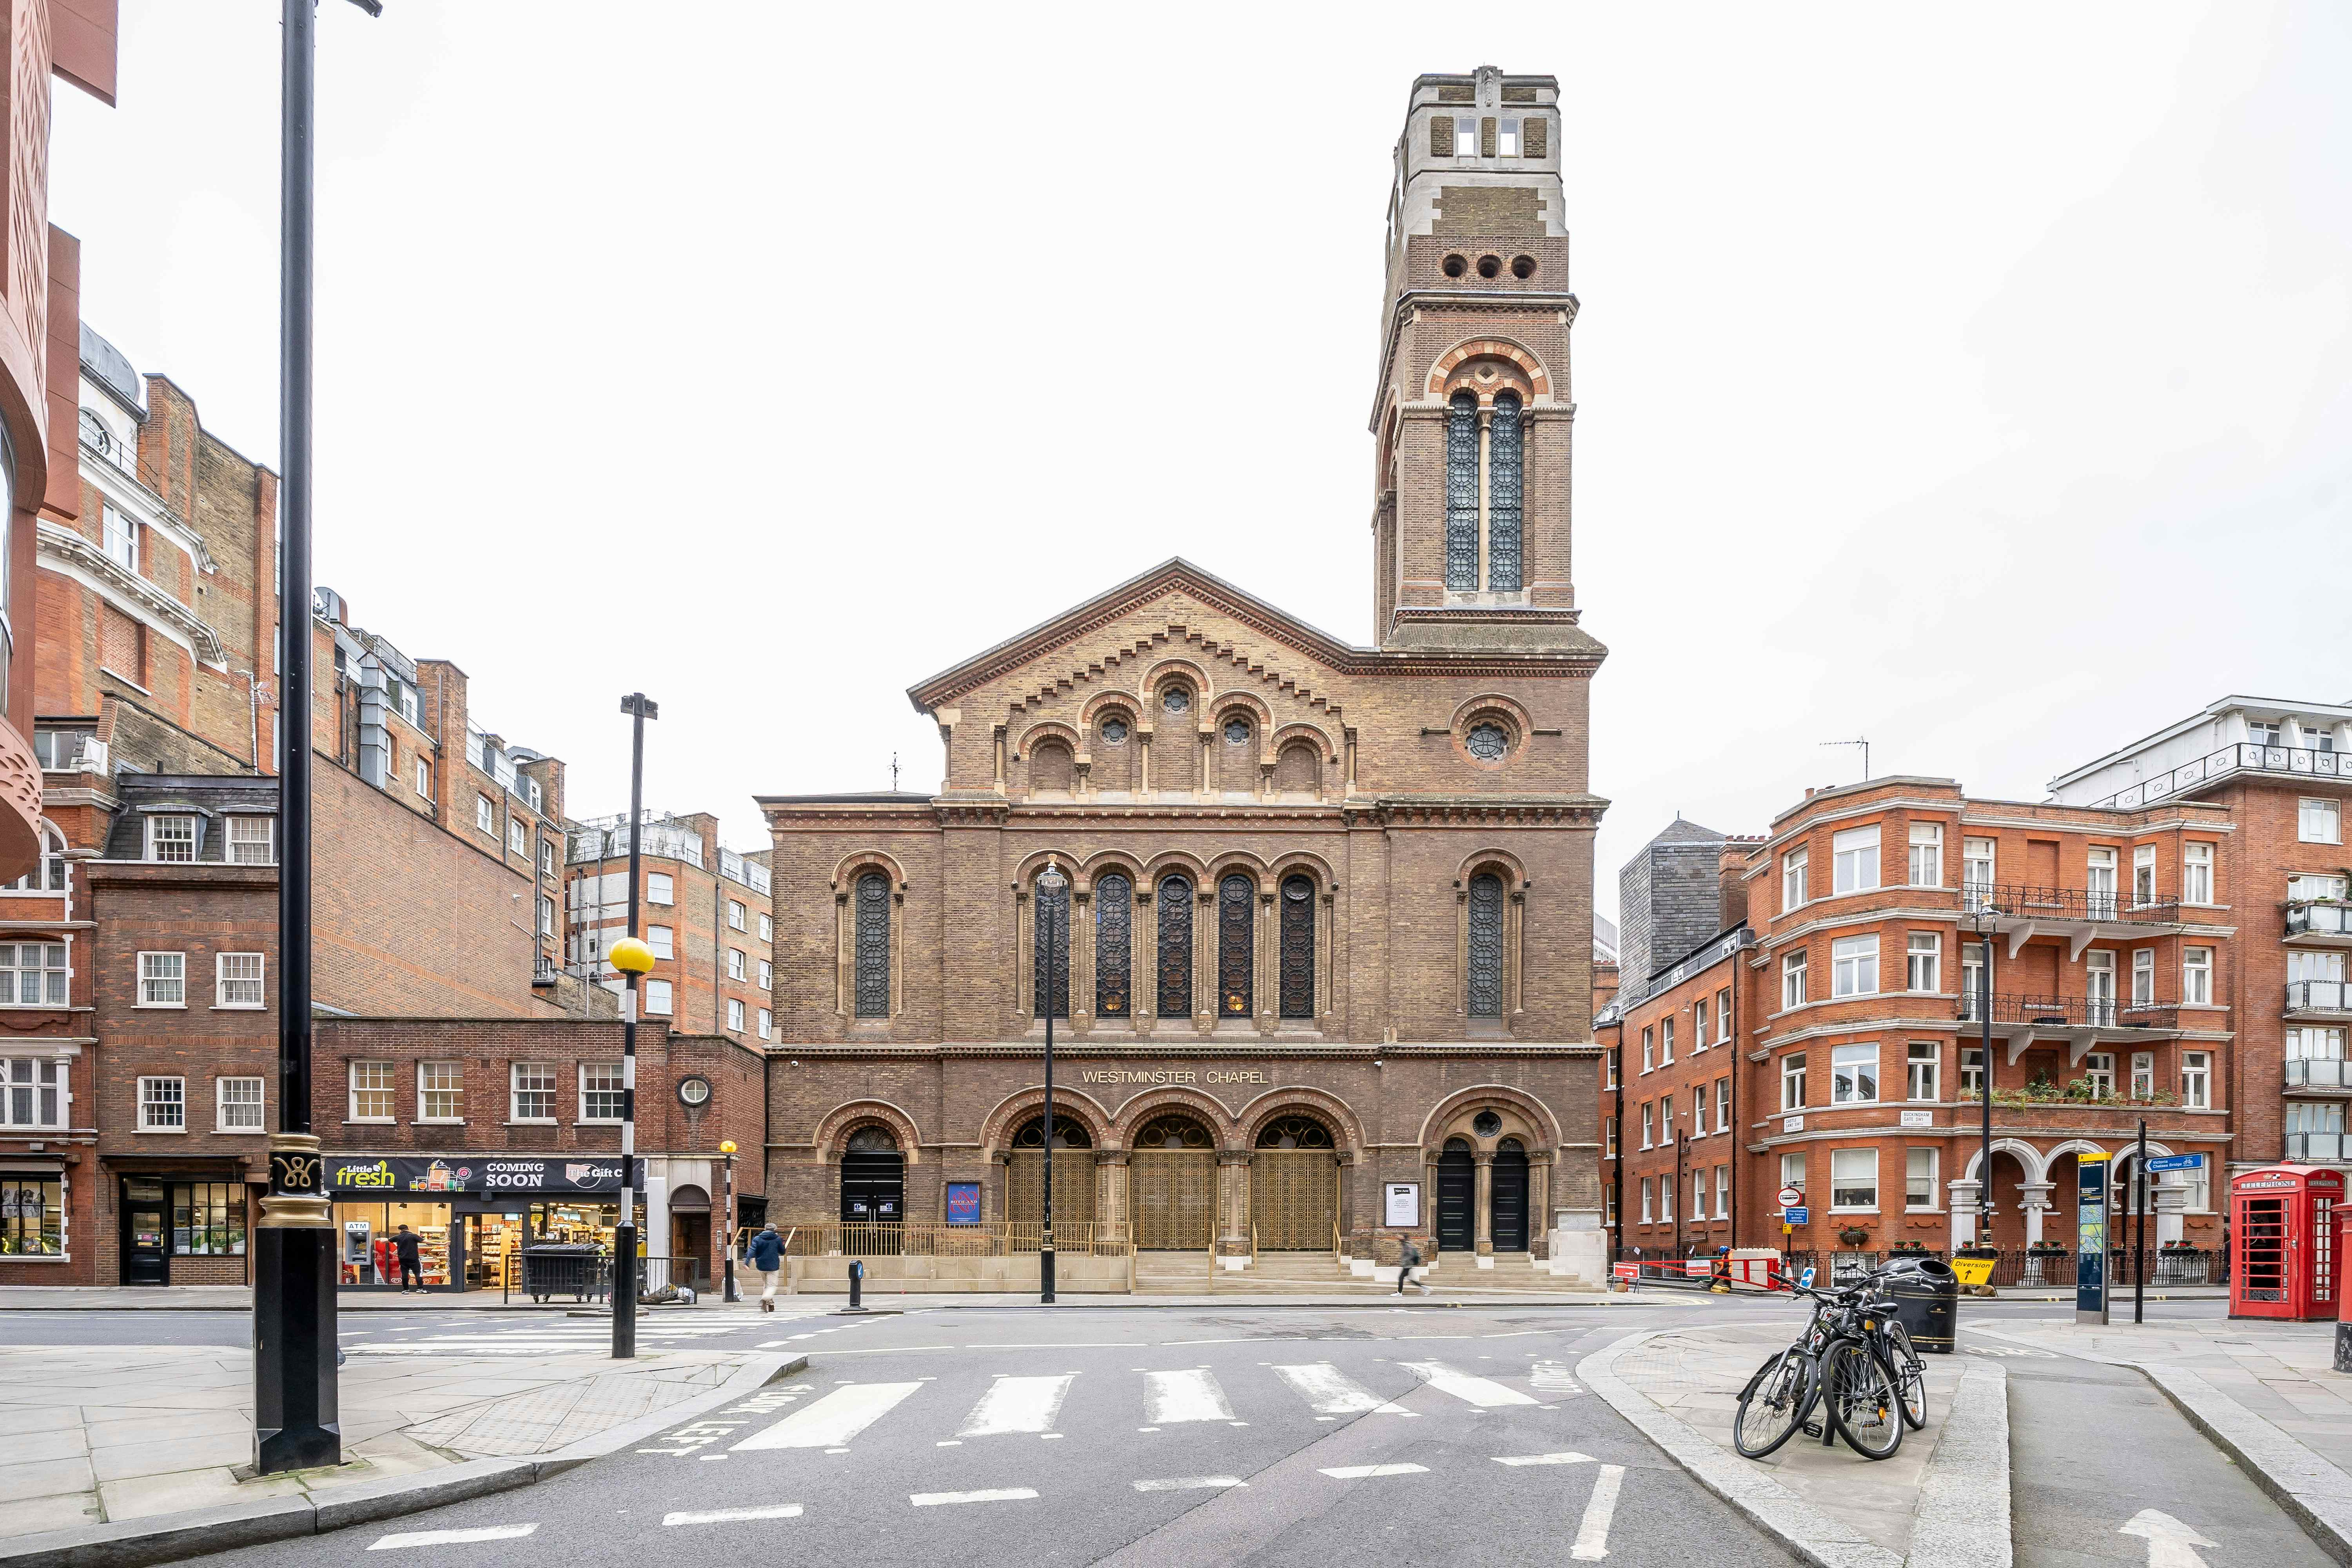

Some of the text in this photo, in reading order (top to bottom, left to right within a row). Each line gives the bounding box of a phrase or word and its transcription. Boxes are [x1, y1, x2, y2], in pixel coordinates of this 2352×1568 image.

[1082, 1071, 1269, 1083] WESTMINSTER CHAPEL
[336, 1160, 395, 1185] fresh
[486, 1163, 545, 1172] COMING
[568, 1169, 590, 1177] The
[592, 1168, 613, 1177] Gift
[486, 1174, 544, 1187] SOON
[635, 1421, 750, 1456] LEFT
